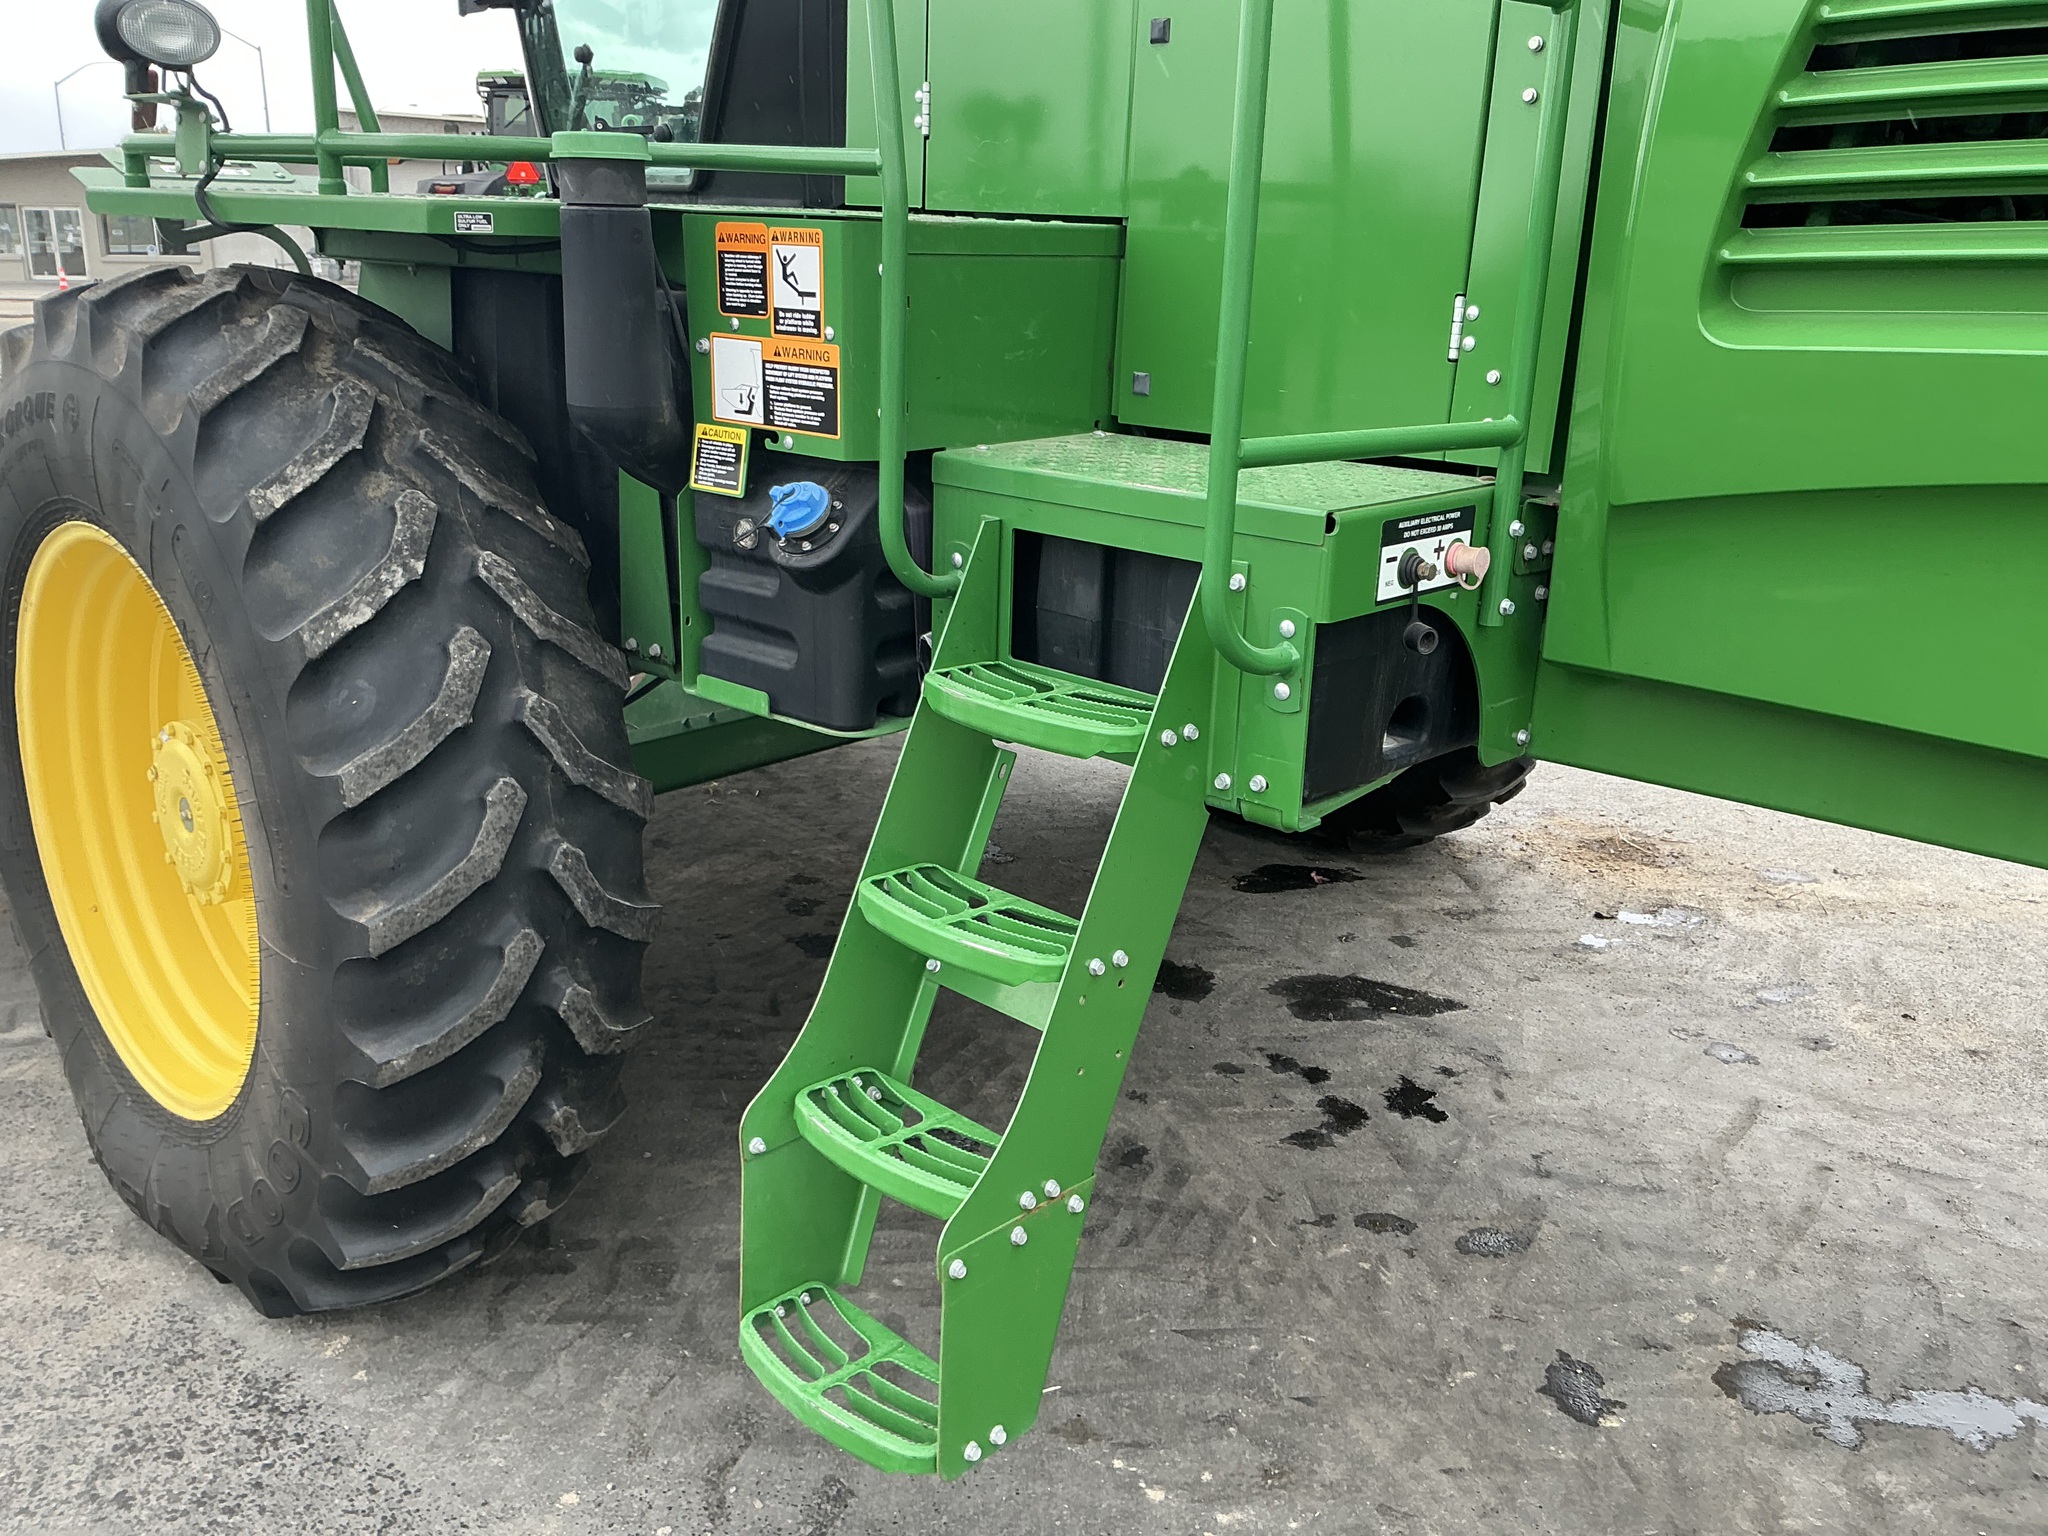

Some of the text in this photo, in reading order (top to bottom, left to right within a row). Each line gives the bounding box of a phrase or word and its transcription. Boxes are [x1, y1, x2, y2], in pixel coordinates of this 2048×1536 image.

[726, 233, 766, 245] WARNING
[779, 231, 820, 244] WARNING
[782, 346, 830, 362] WARNING
[708, 428, 742, 441] CAUTION
[1420, 515, 1445, 525] ELECTRICAL
[1446, 511, 1461, 520] POWER
[1410, 529, 1420, 537] NOT
[1420, 526, 1437, 535] EXCEED
[1442, 522, 1454, 531] AMPS
